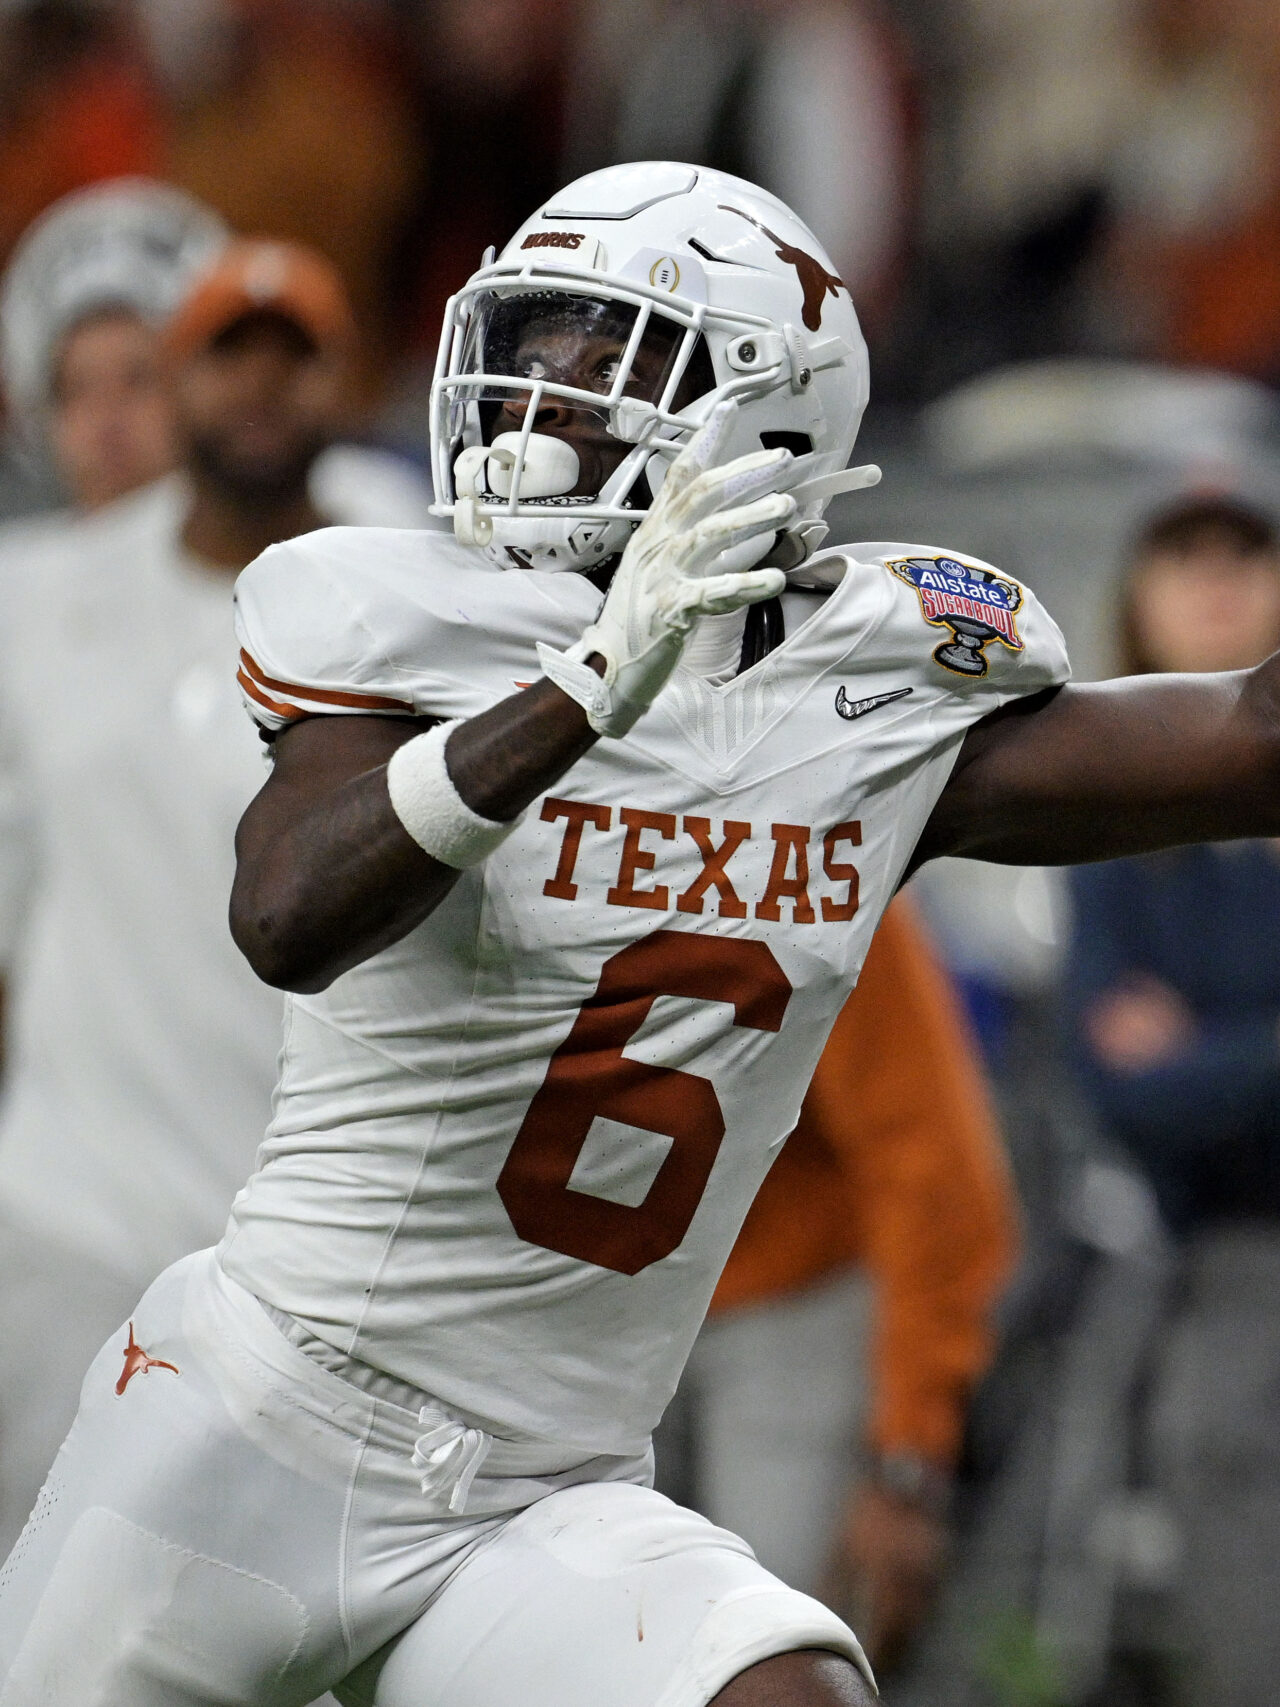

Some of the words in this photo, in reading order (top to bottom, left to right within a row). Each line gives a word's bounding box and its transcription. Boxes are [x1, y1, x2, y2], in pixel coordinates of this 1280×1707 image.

[920, 571, 1001, 603] Allstate
[539, 797, 862, 924] TEXAS
[496, 930, 794, 1276] 6
